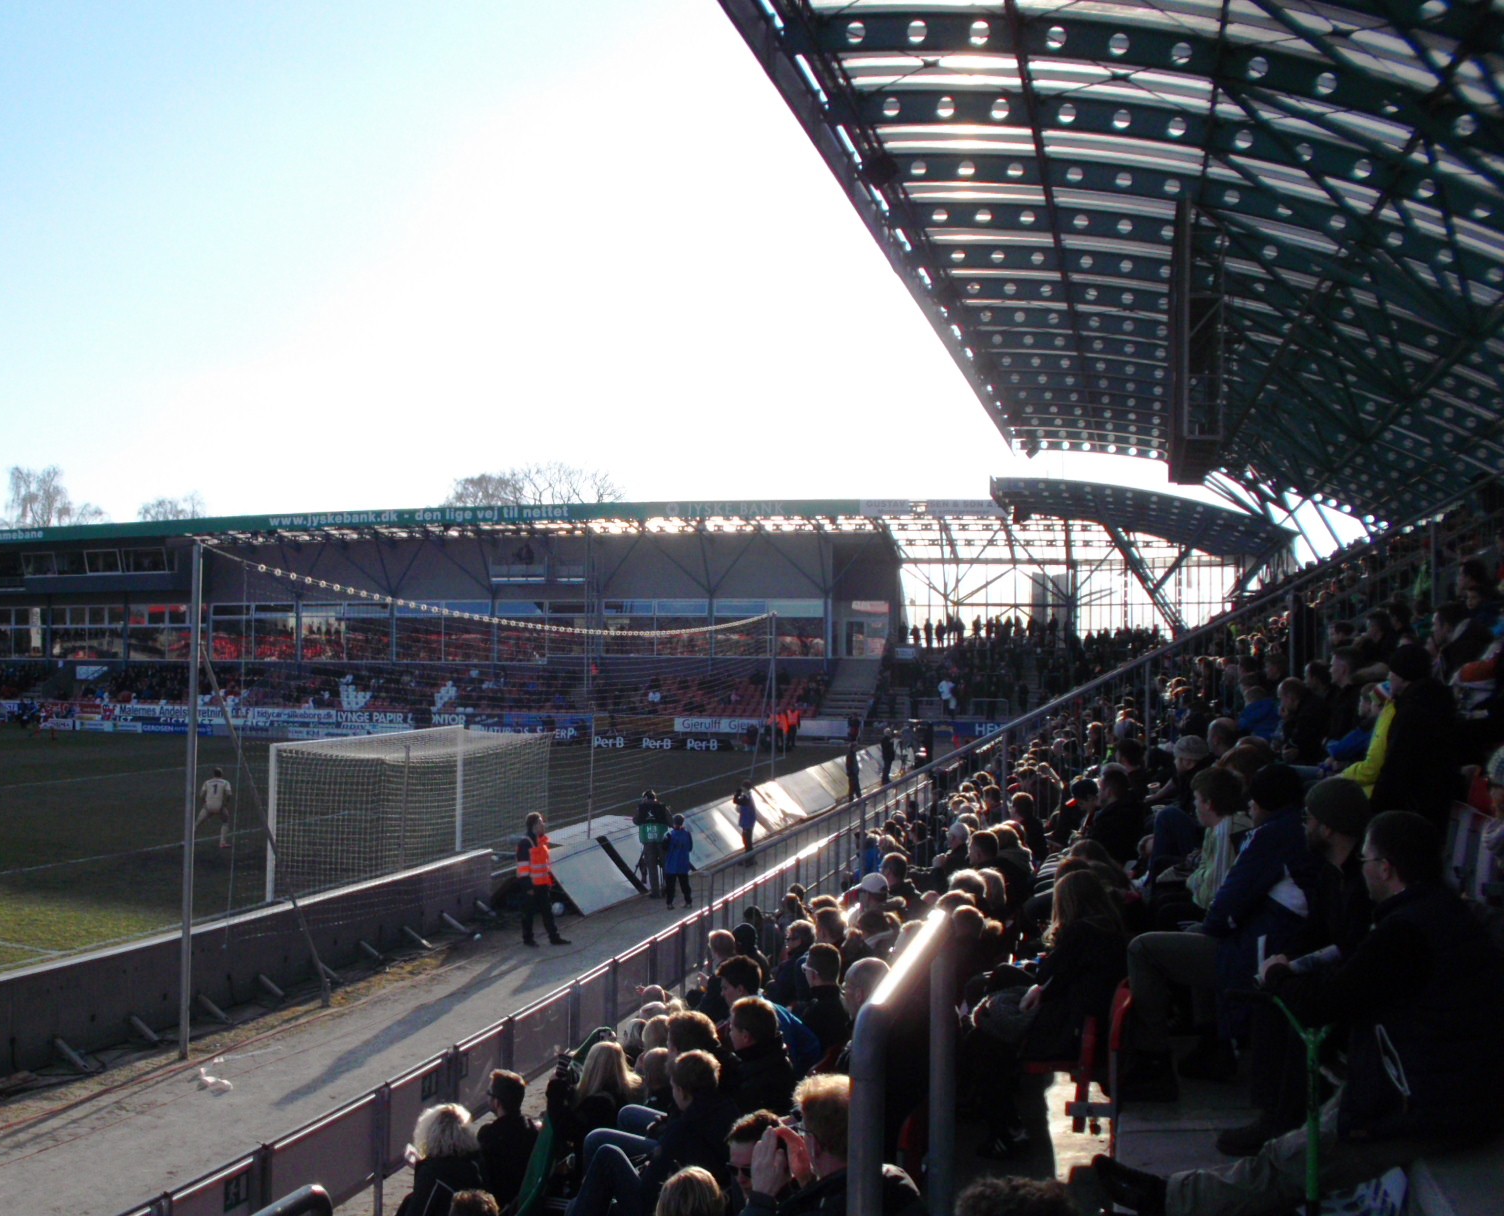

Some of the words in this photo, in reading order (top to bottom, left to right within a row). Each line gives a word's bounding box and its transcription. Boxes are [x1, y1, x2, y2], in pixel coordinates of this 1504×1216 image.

[269, 511, 398, 526] www.jyskebank.dk
[415, 510, 441, 521] den
[446, 508, 472, 523] lige
[477, 508, 498, 521] vej
[503, 507, 518, 518] til
[523, 506, 569, 518] nettet
[687, 502, 734, 516] JYSKE
[740, 502, 785, 515] BANK
[337, 711, 370, 723] LYNGE
[373, 712, 403, 723] PAPIR
